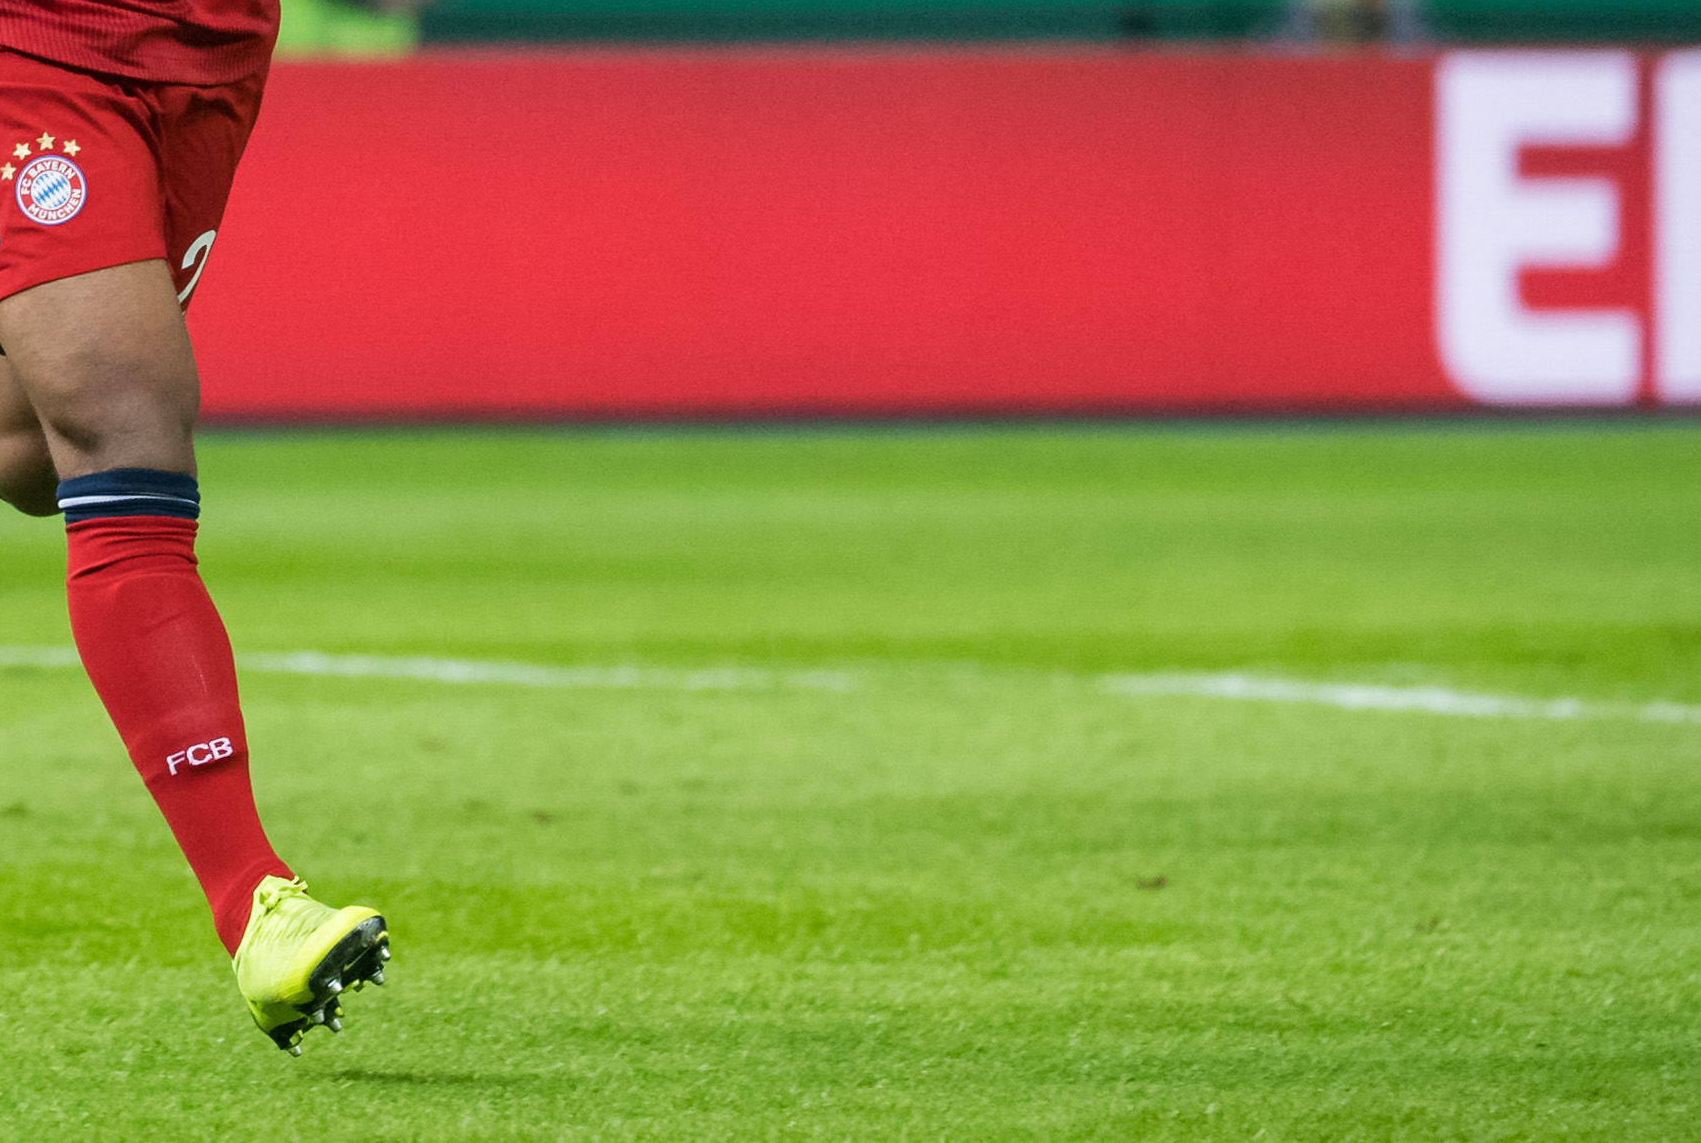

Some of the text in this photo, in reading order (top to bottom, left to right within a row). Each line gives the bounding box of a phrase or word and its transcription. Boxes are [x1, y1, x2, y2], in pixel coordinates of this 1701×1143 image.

[20, 160, 76, 195] FC BAYERN
[1432, 48, 1701, 406] E
[165, 736, 234, 777] FCB
